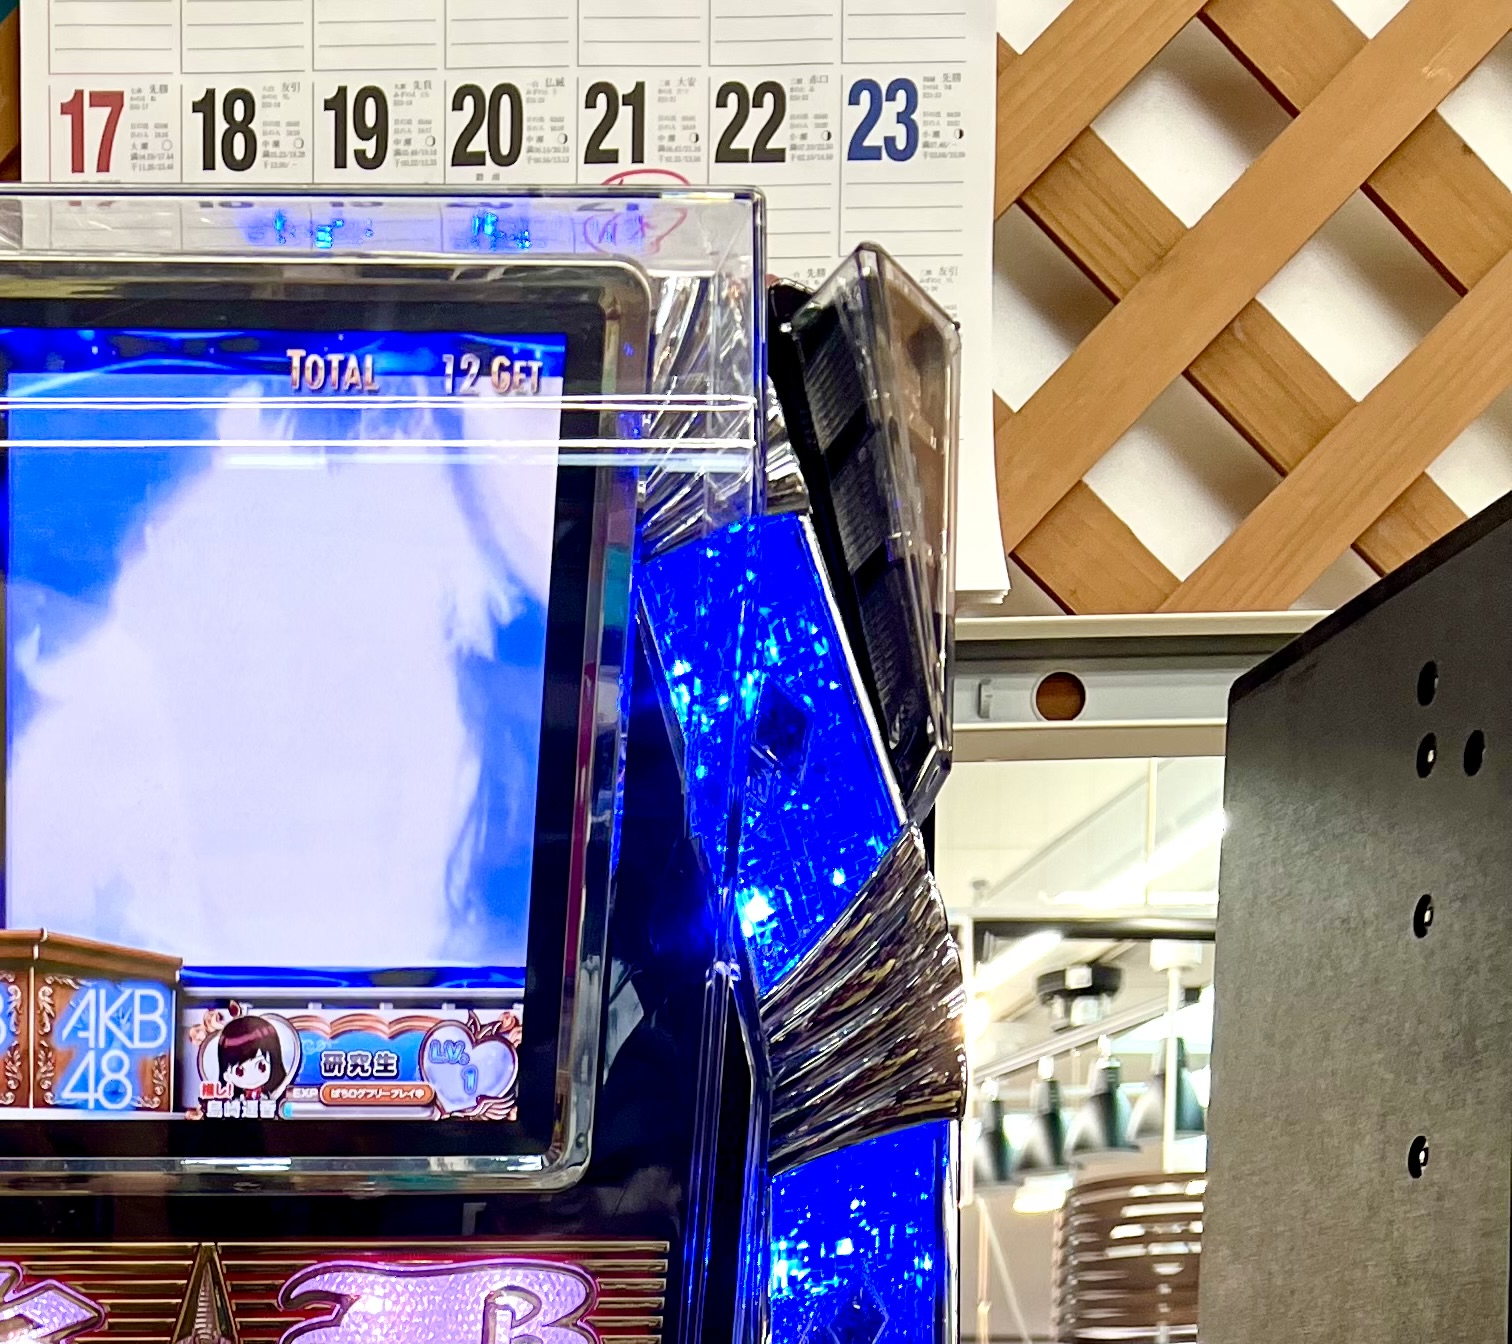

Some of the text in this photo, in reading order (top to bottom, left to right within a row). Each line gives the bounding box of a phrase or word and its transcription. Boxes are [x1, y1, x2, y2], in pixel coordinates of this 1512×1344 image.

[60, 89, 125, 174] 17
[192, 88, 258, 172] 18
[323, 85, 389, 170] 19
[451, 82, 523, 167] 20
[584, 81, 645, 164] 21
[715, 80, 786, 163] 22
[847, 77, 919, 162] 23
[286, 348, 544, 395] TOTAL 12 GET
[61, 987, 168, 1049] AKB
[61, 1049, 133, 1110] 48
[292, 1088, 318, 1099] EXP
[320, 1049, 399, 1079] 研究生
[461, 1064, 479, 1093] 1
